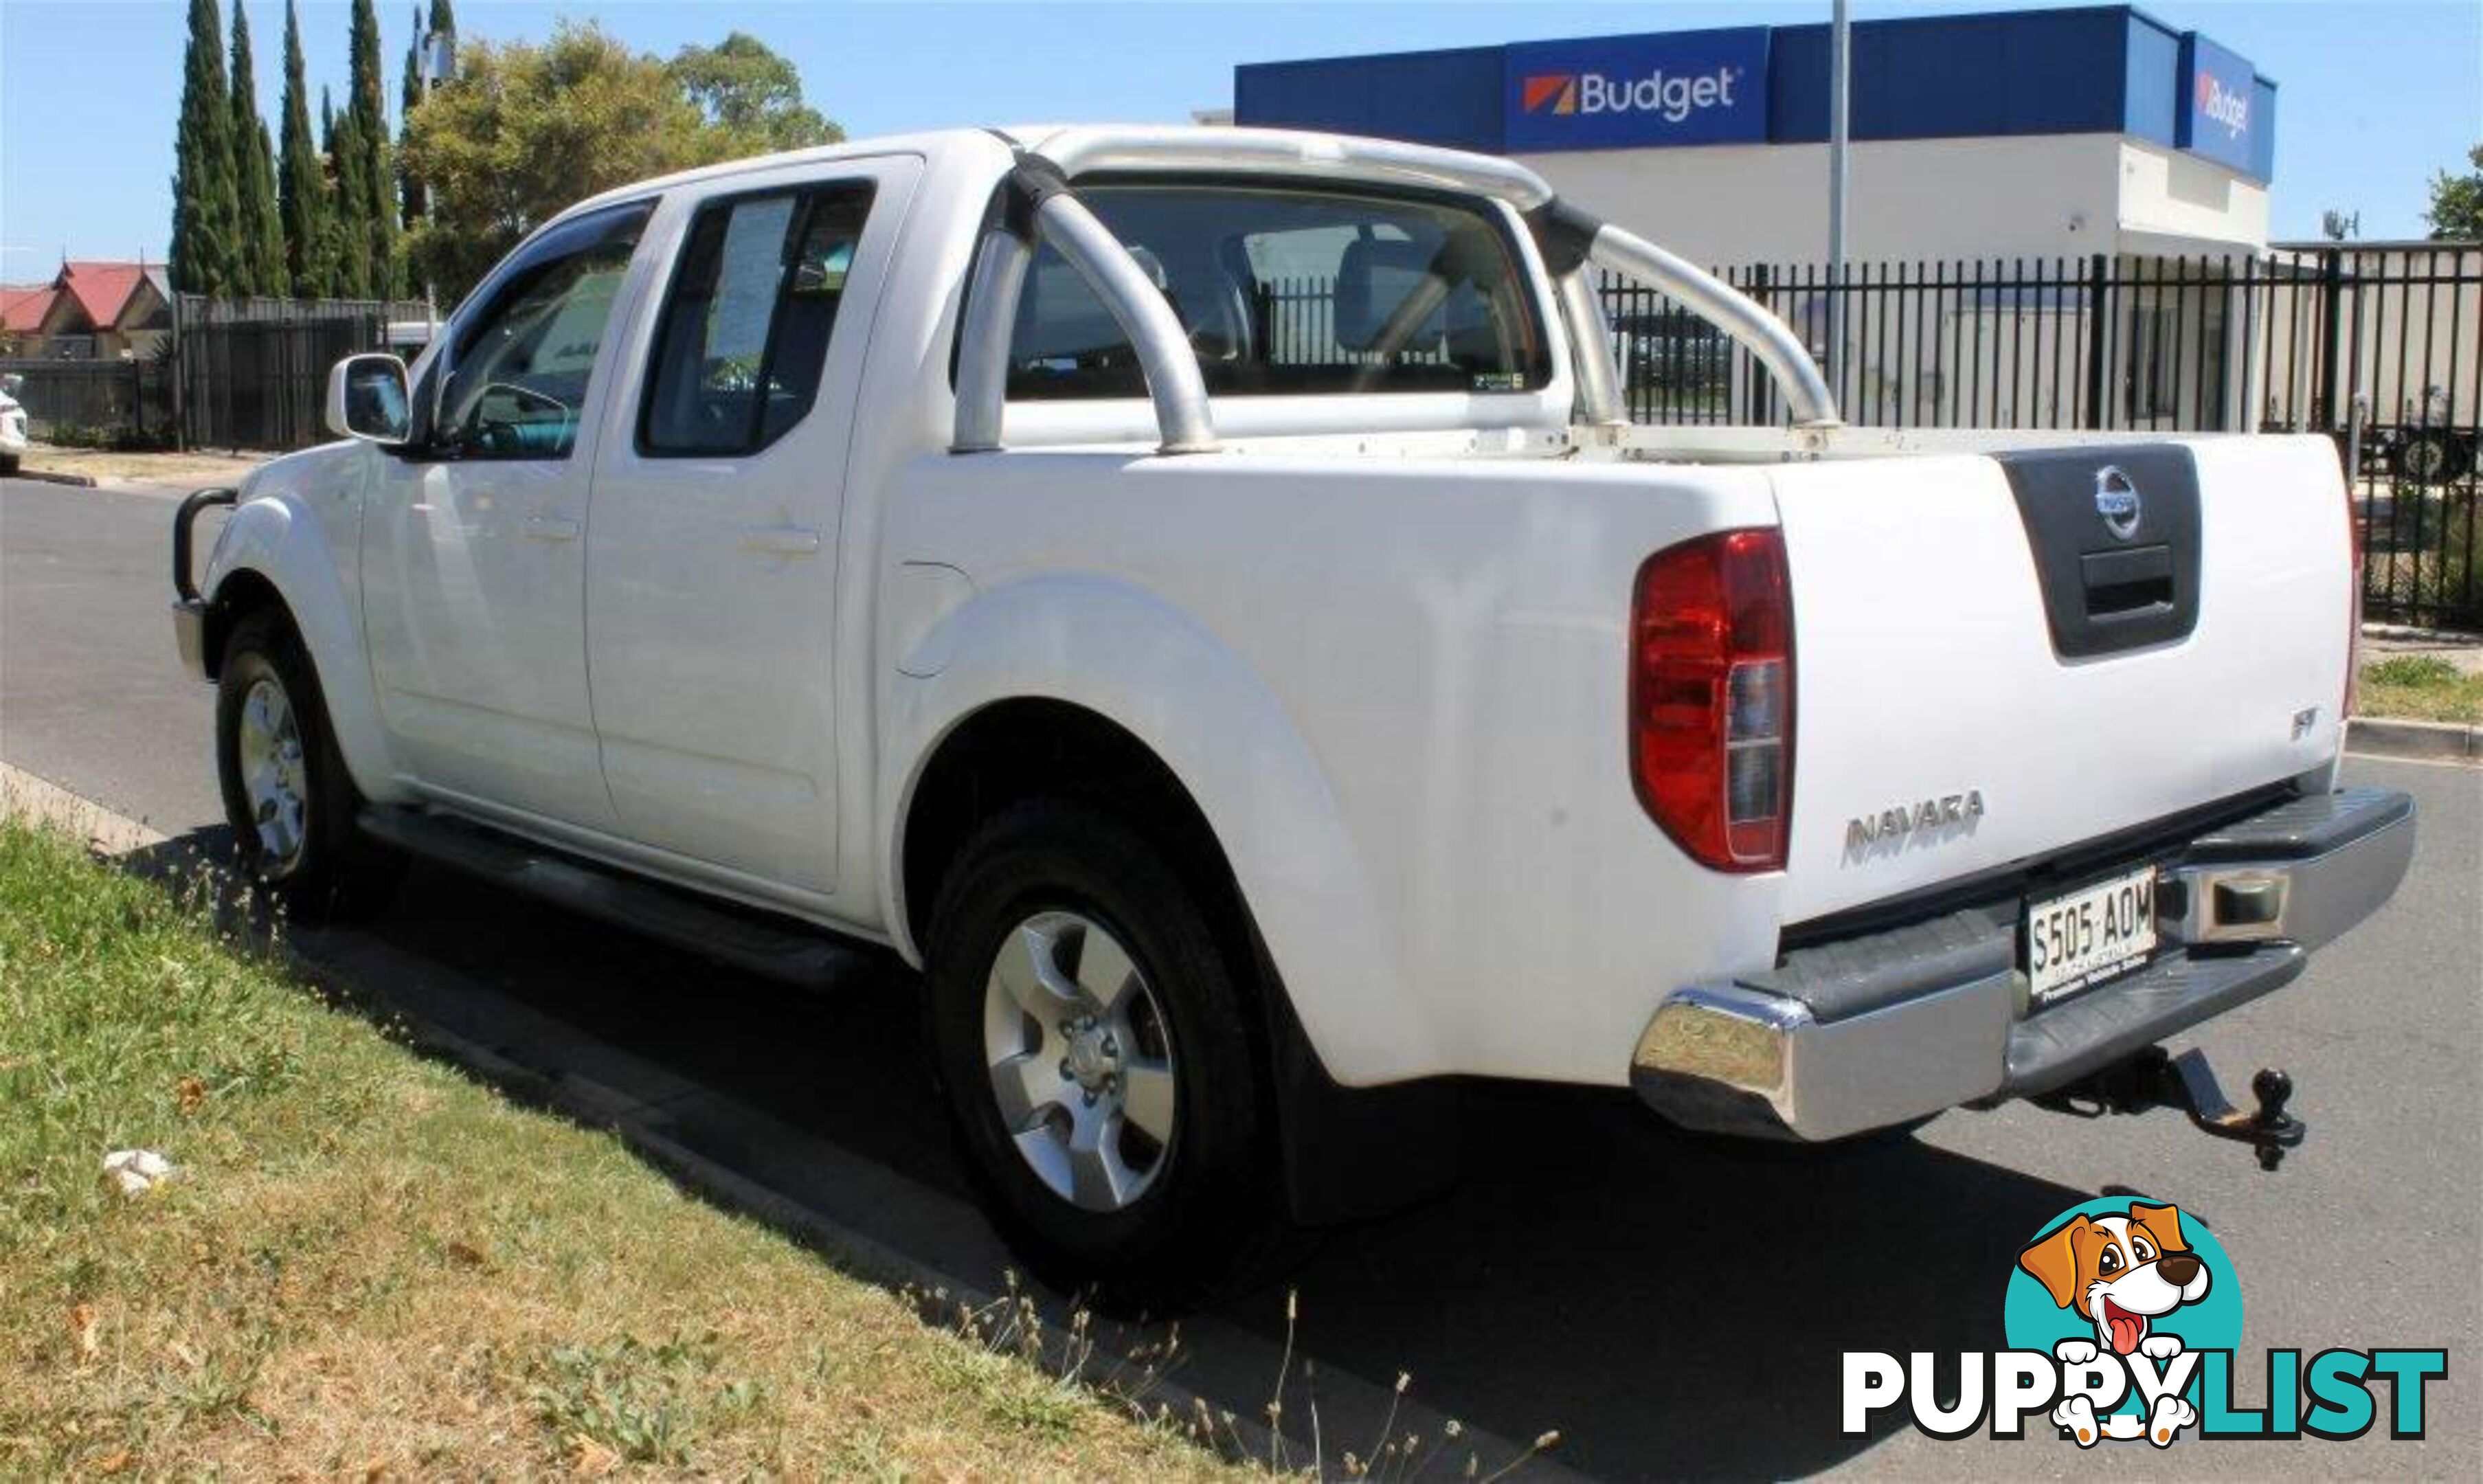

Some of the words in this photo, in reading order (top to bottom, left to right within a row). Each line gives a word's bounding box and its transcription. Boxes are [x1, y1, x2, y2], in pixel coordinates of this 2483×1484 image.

[1581, 67, 1733, 122] Budget
[2206, 79, 2248, 139] Budget
[1845, 789, 1984, 852] NAVARA
[2033, 901, 2093, 972] S505
[2104, 880, 2153, 947] AOM
